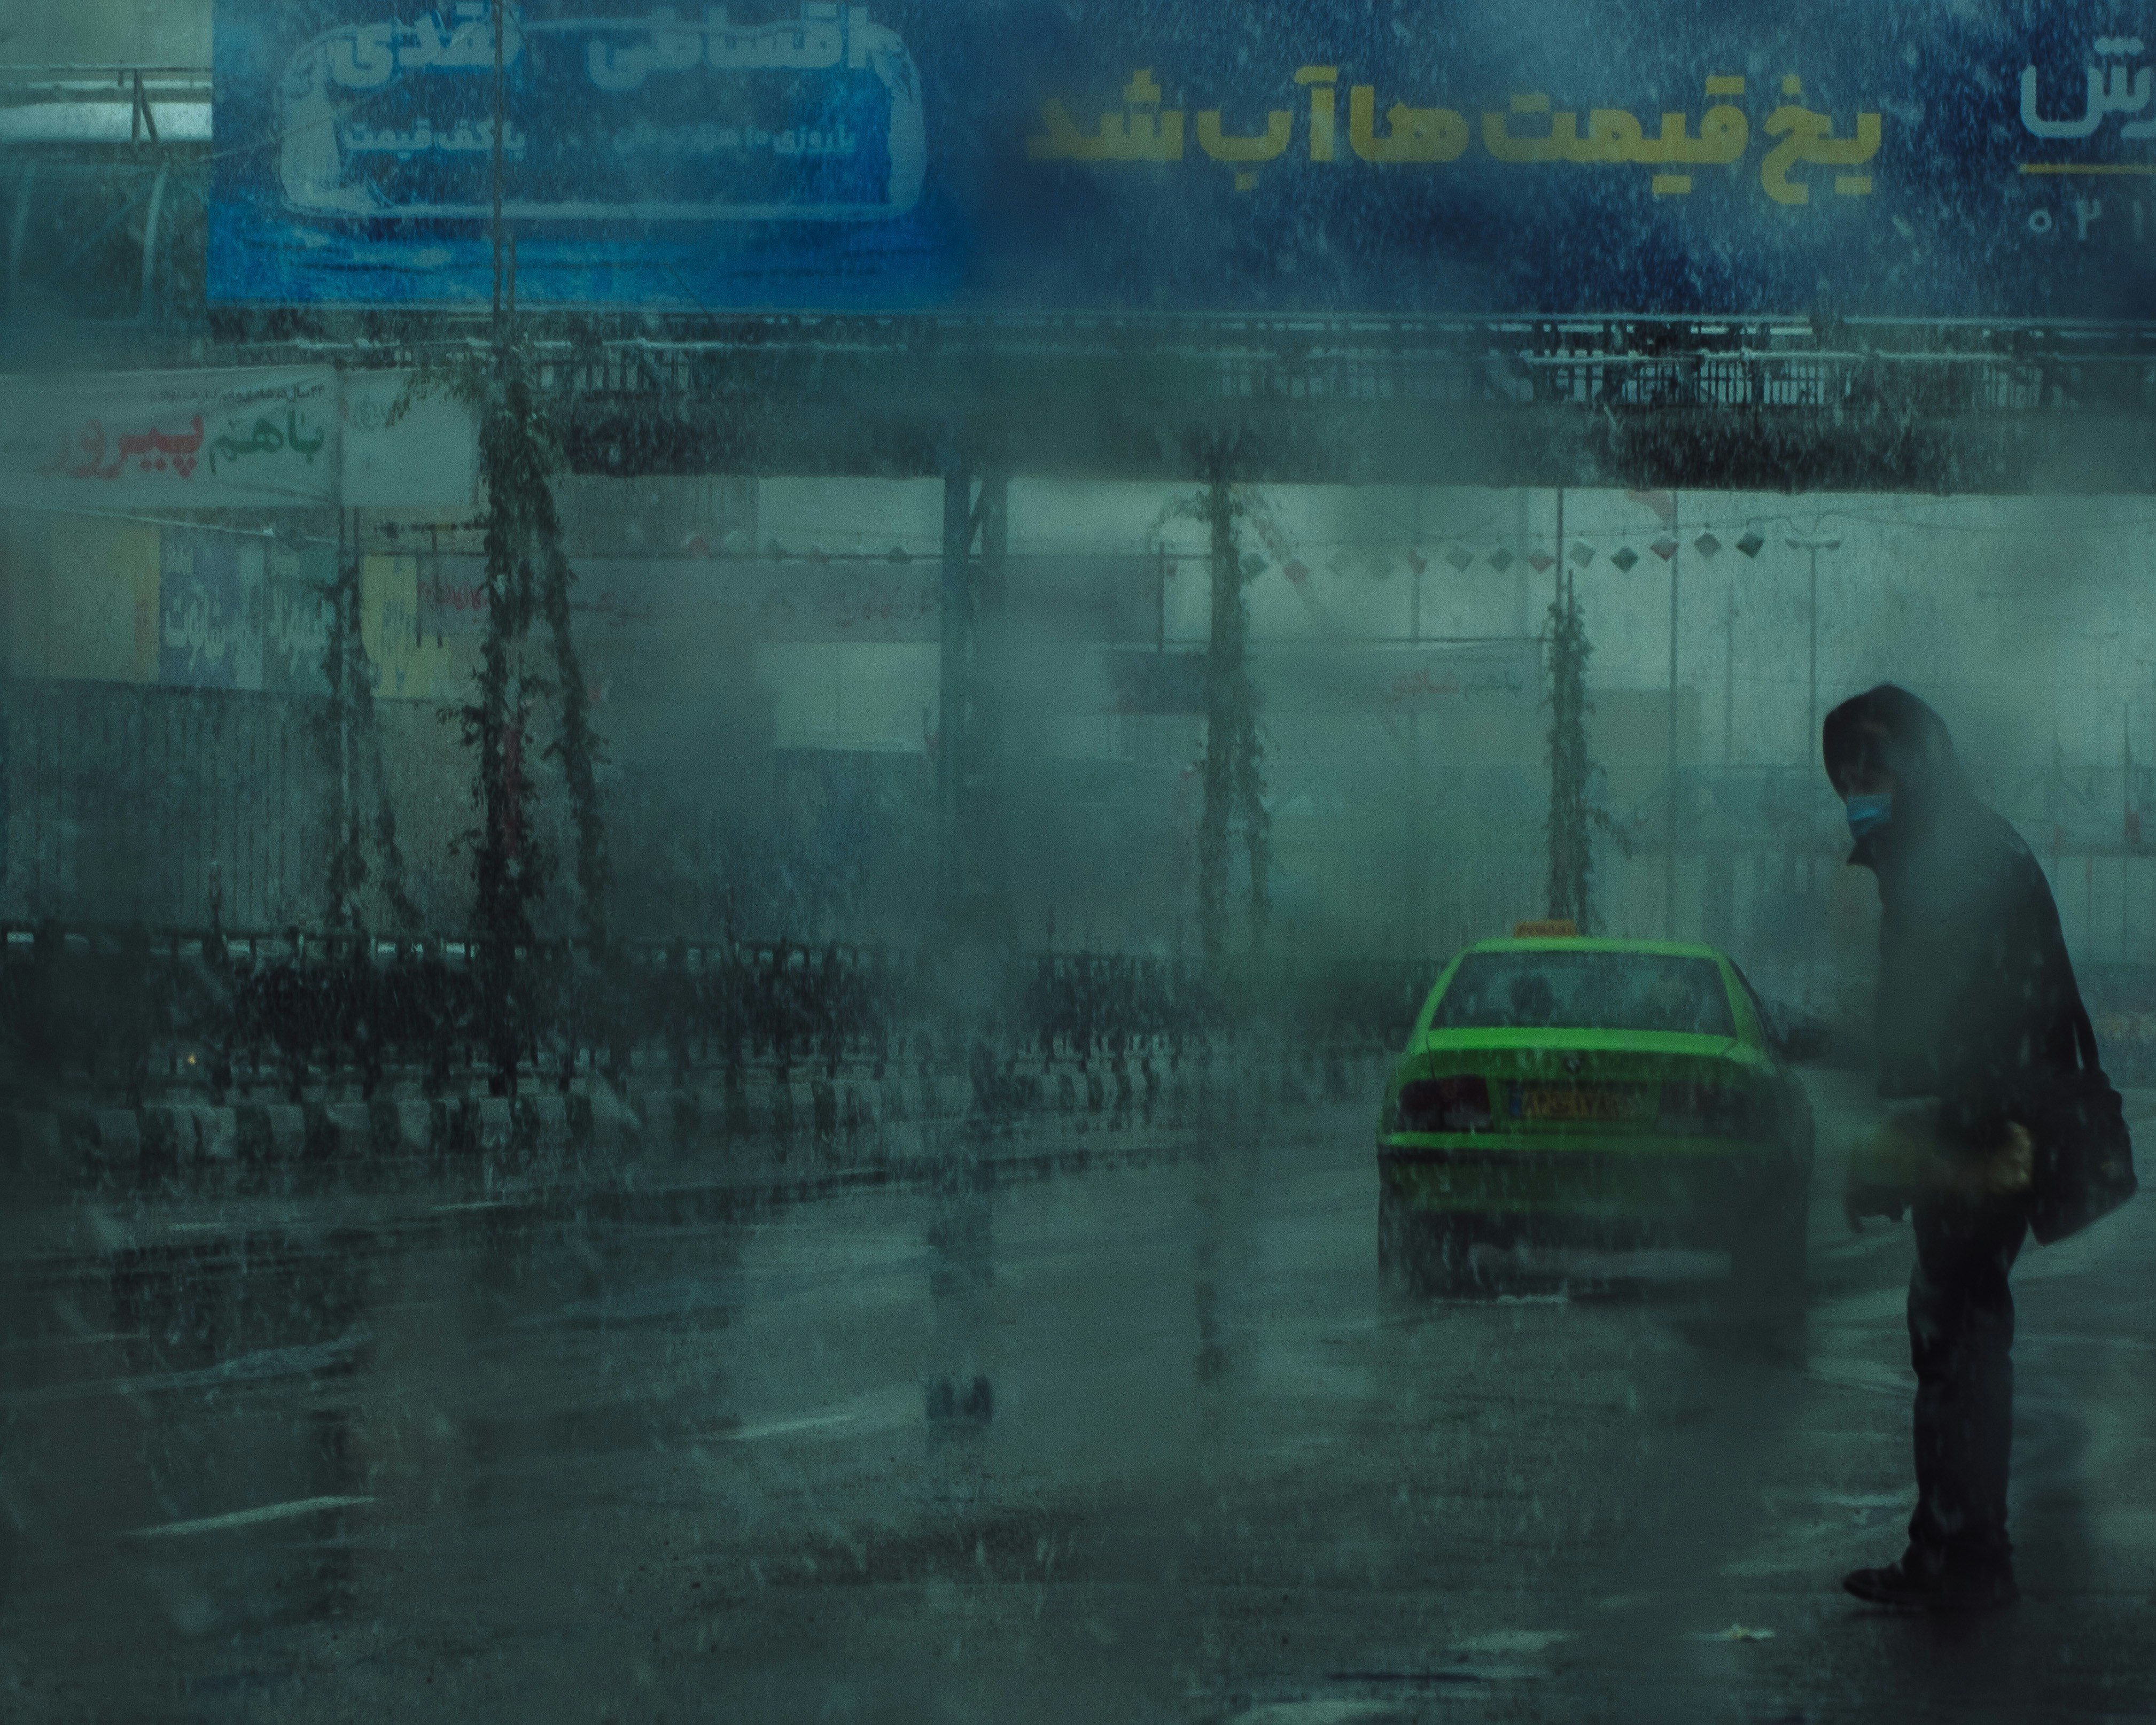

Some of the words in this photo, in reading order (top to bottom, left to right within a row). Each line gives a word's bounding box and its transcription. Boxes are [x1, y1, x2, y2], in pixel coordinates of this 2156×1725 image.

[587, 3, 868, 91] اقساطی
[344, 116, 432, 161] قیمت
[1024, 68, 1184, 161] شد
[1195, 65, 1338, 191] آب
[1350, 86, 1470, 163] ها
[1481, 76, 1747, 195] قیمت
[1761, 74, 1883, 205] یخ
